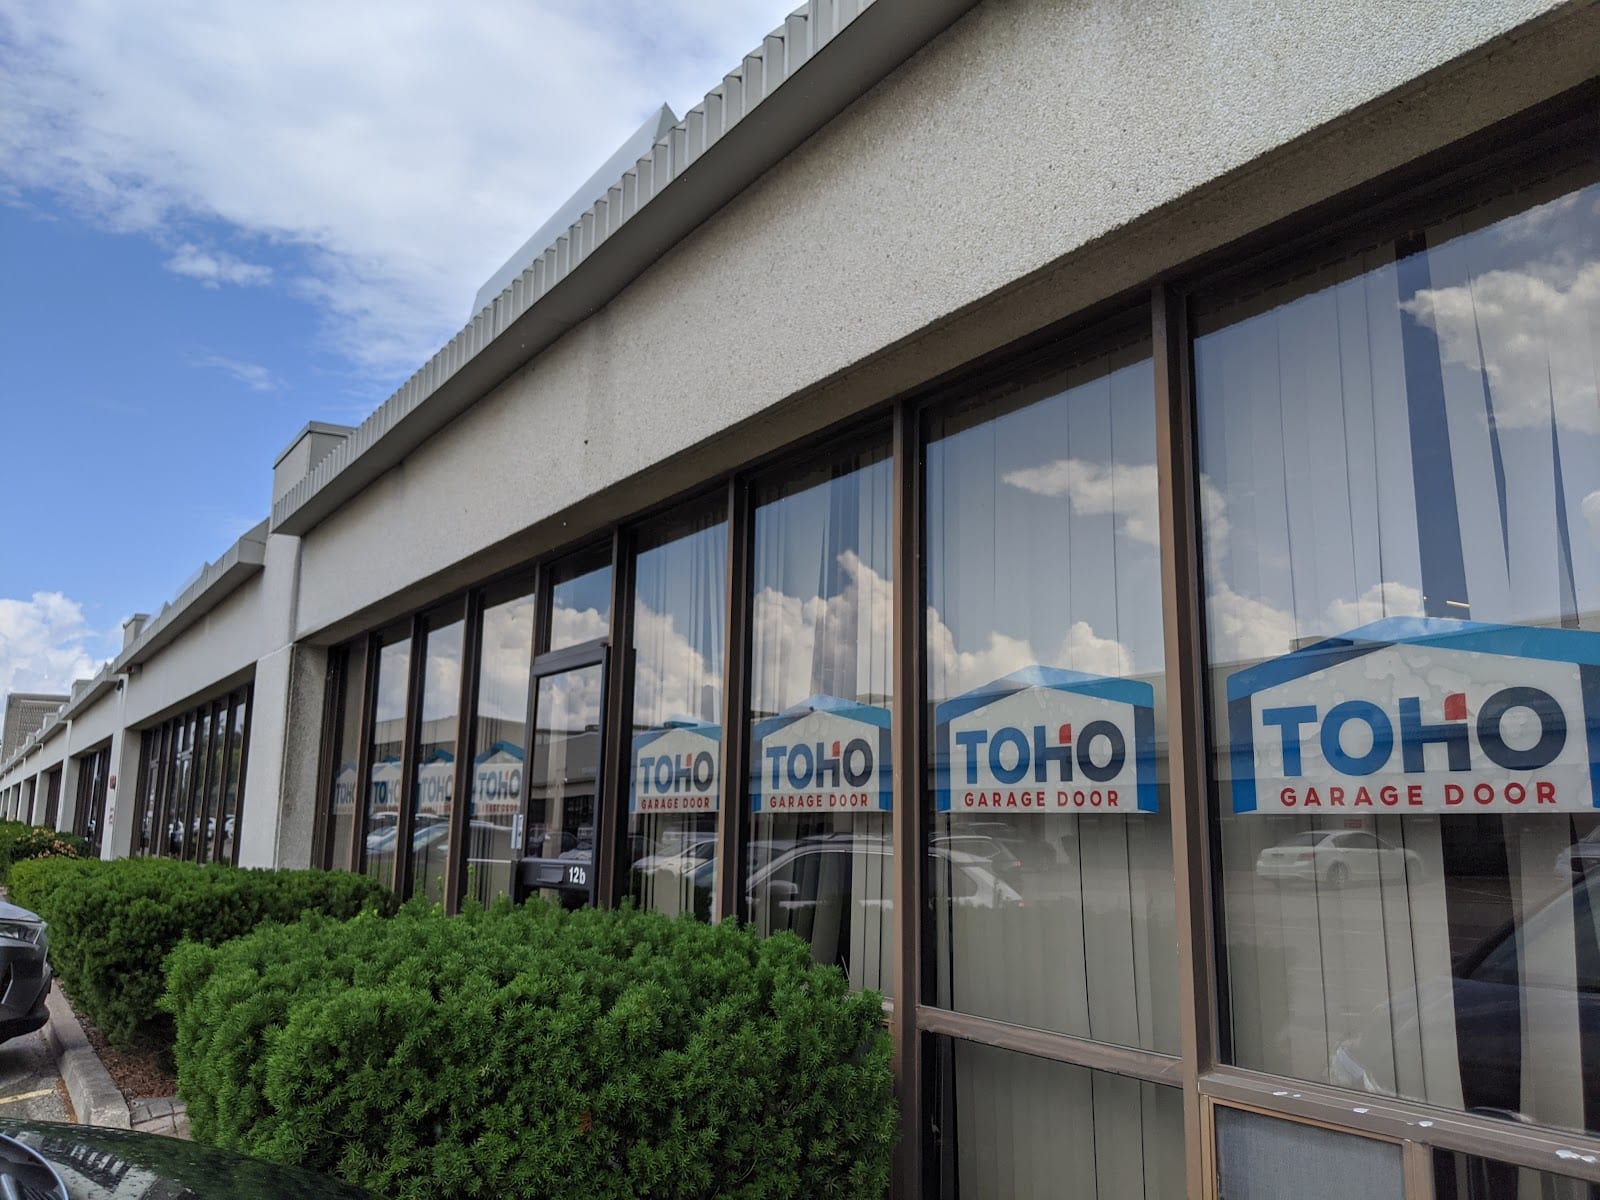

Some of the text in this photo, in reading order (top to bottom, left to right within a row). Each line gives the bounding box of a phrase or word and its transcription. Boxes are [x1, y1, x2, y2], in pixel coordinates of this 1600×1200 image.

[1262, 686, 1567, 776] TOHO
[766, 738, 873, 790] TOHO
[956, 720, 1126, 784] TOHO
[479, 769, 520, 800] TOHO
[640, 751, 714, 794] TOHO
[641, 797, 710, 810] GARAGE DOOR
[770, 793, 868, 808] GARAGE DOOR
[964, 790, 1119, 807] GARAGE DOOR
[1280, 782, 1556, 807] GARAGE DOOR
[568, 866, 586, 885] 12b
